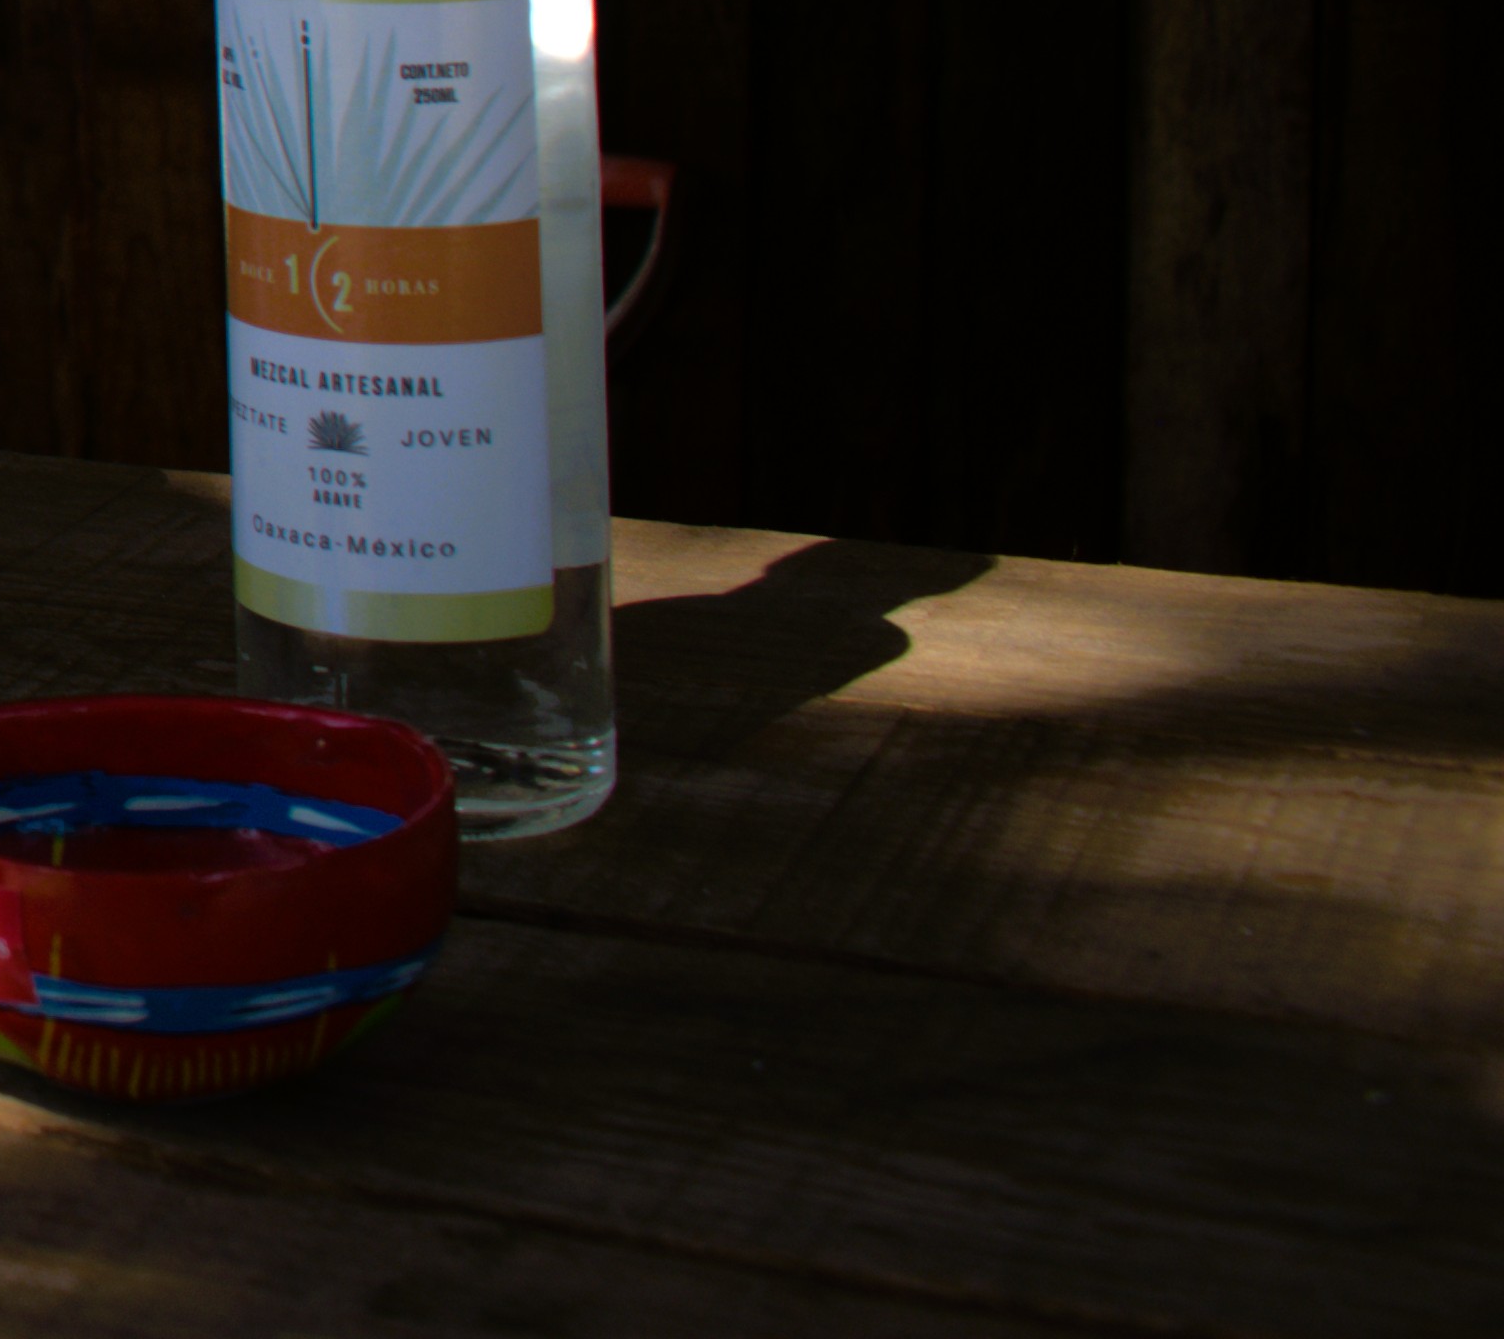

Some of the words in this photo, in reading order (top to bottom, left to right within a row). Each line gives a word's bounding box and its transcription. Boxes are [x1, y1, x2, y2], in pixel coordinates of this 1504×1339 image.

[400, 62, 469, 80] CONT.NETO
[413, 87, 458, 104] 250ML
[240, 261, 275, 283] DOCE
[364, 278, 439, 296] HORAS
[250, 356, 309, 389] MEZCAL
[317, 370, 443, 397] ARTESANAL
[400, 427, 492, 448] JOVEN
[308, 466, 367, 489] 100%
[312, 489, 362, 510] AGAVE
[252, 513, 456, 559] Oaxaca-México
